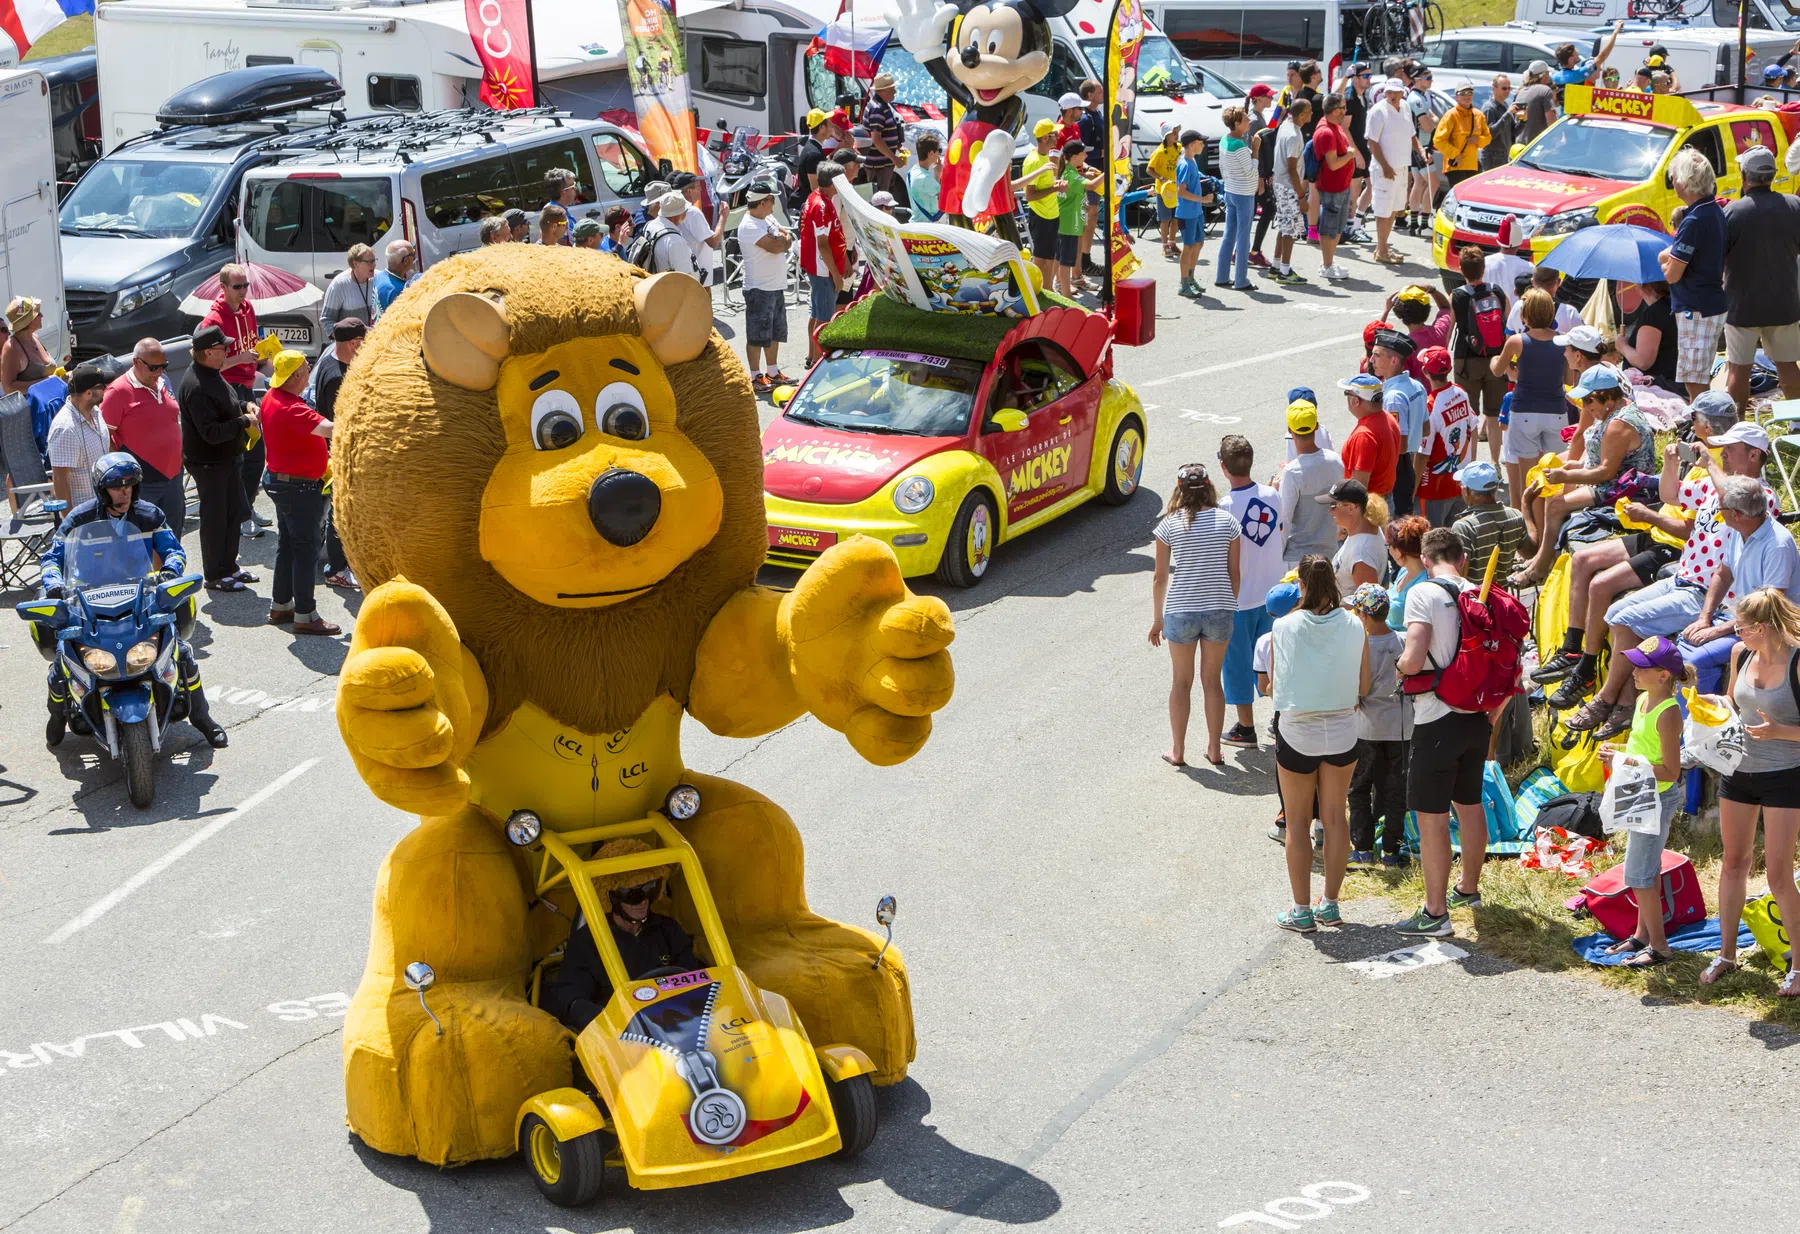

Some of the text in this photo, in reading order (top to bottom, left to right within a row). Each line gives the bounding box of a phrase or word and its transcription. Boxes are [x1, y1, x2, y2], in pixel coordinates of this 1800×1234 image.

[1570, 7, 1580, 15] TTC
[203, 39, 240, 62] Tandy
[4, 78, 34, 92] RIMOR
[1605, 91, 1640, 100] JOURNAL
[1594, 97, 1652, 116] MICKEY
[1479, 213, 1503, 224] ISUZ
[911, 243, 959, 255] MICKE
[876, 351, 947, 366] CARAVANE 2438
[1446, 402, 1467, 422] Vittel
[802, 439, 871, 451] JOURNAL
[1006, 429, 1071, 465] LE JOURNAL DE
[774, 444, 892, 474] MICKEY
[1011, 443, 1072, 494] MICKEY
[780, 533, 819, 547] MICKEY
[86, 588, 136, 602] GENDARMERIE
[557, 735, 583, 756] LCL
[606, 727, 631, 749] LCL
[622, 761, 648, 779] LCL
[670, 971, 709, 987] 2474
[267, 992, 350, 1021] ES
[721, 1017, 753, 1030] LCL
[1217, 1180, 1371, 1230] COL
